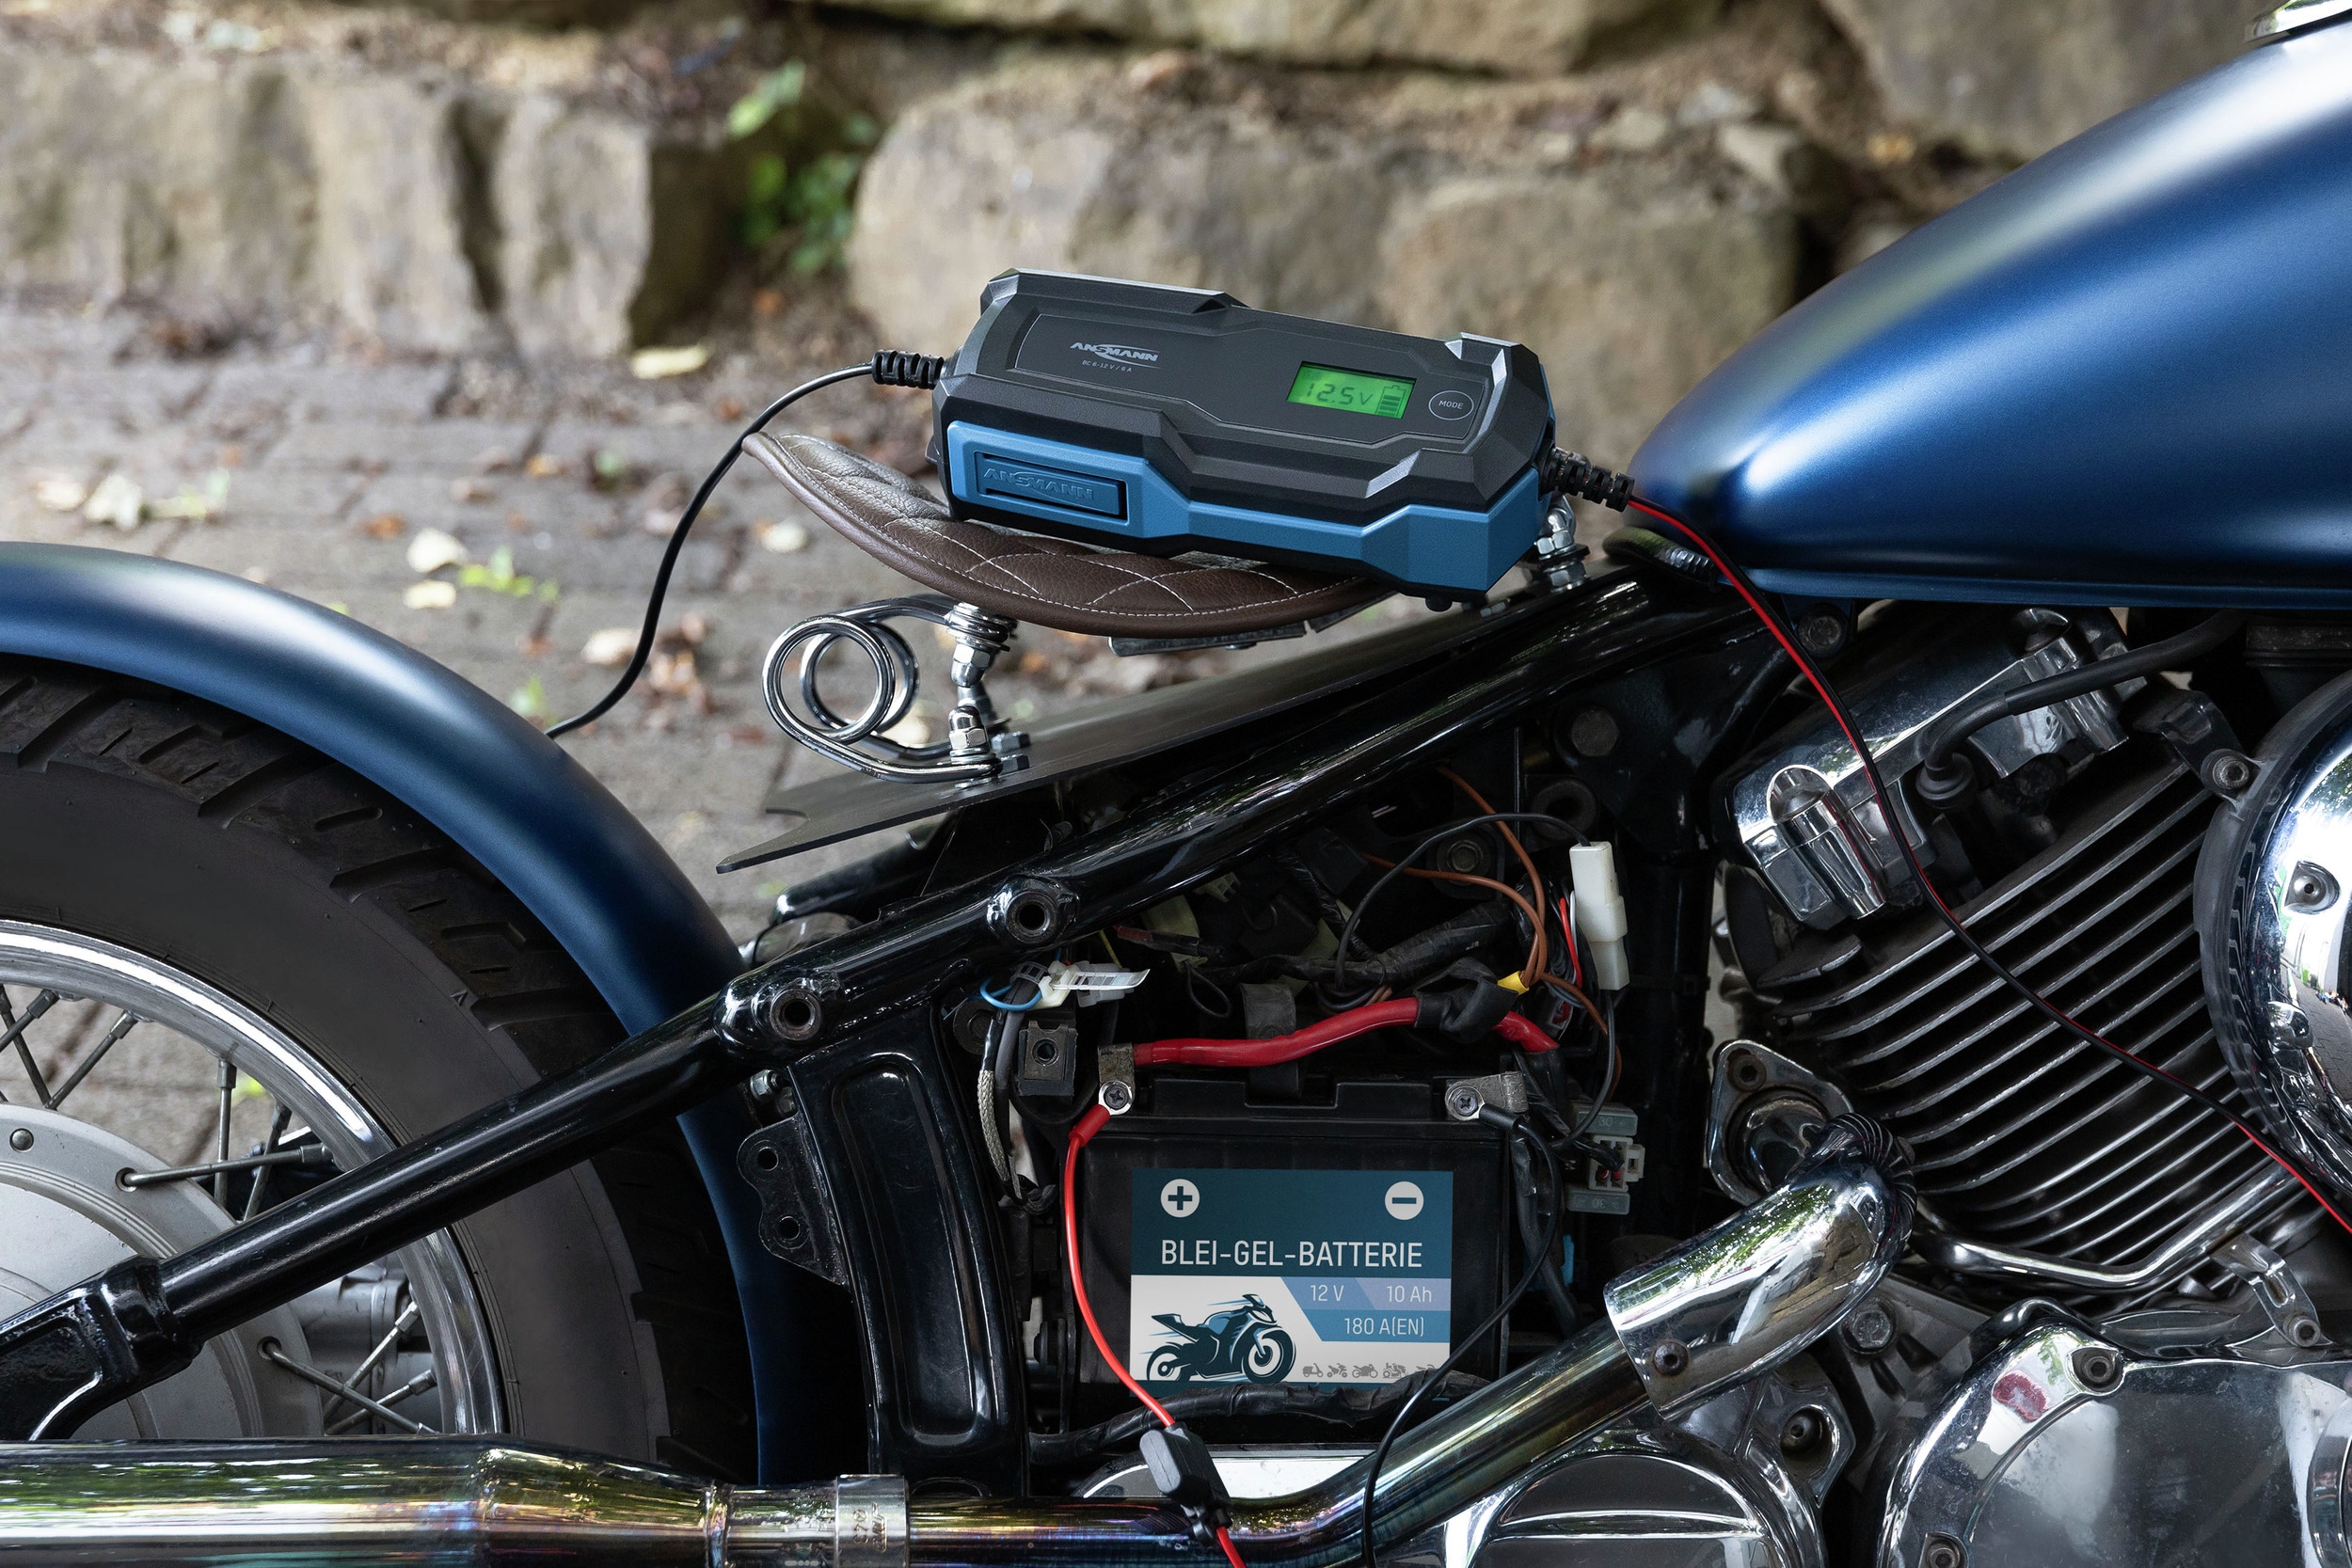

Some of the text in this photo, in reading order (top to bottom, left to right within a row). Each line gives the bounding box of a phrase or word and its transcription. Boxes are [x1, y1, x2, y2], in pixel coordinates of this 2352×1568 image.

[1070, 341, 1158, 361] ANSMANN
[1438, 400, 1464, 410] MODE
[983, 467, 1094, 500] ANSMANN
[1161, 1239, 1422, 1268] BLEI-GEL-BATTERIE
[1311, 1284, 1344, 1302] 12 V
[1387, 1285, 1433, 1303] 10 Ah
[1344, 1316, 1424, 1337] 180 A(EN)
